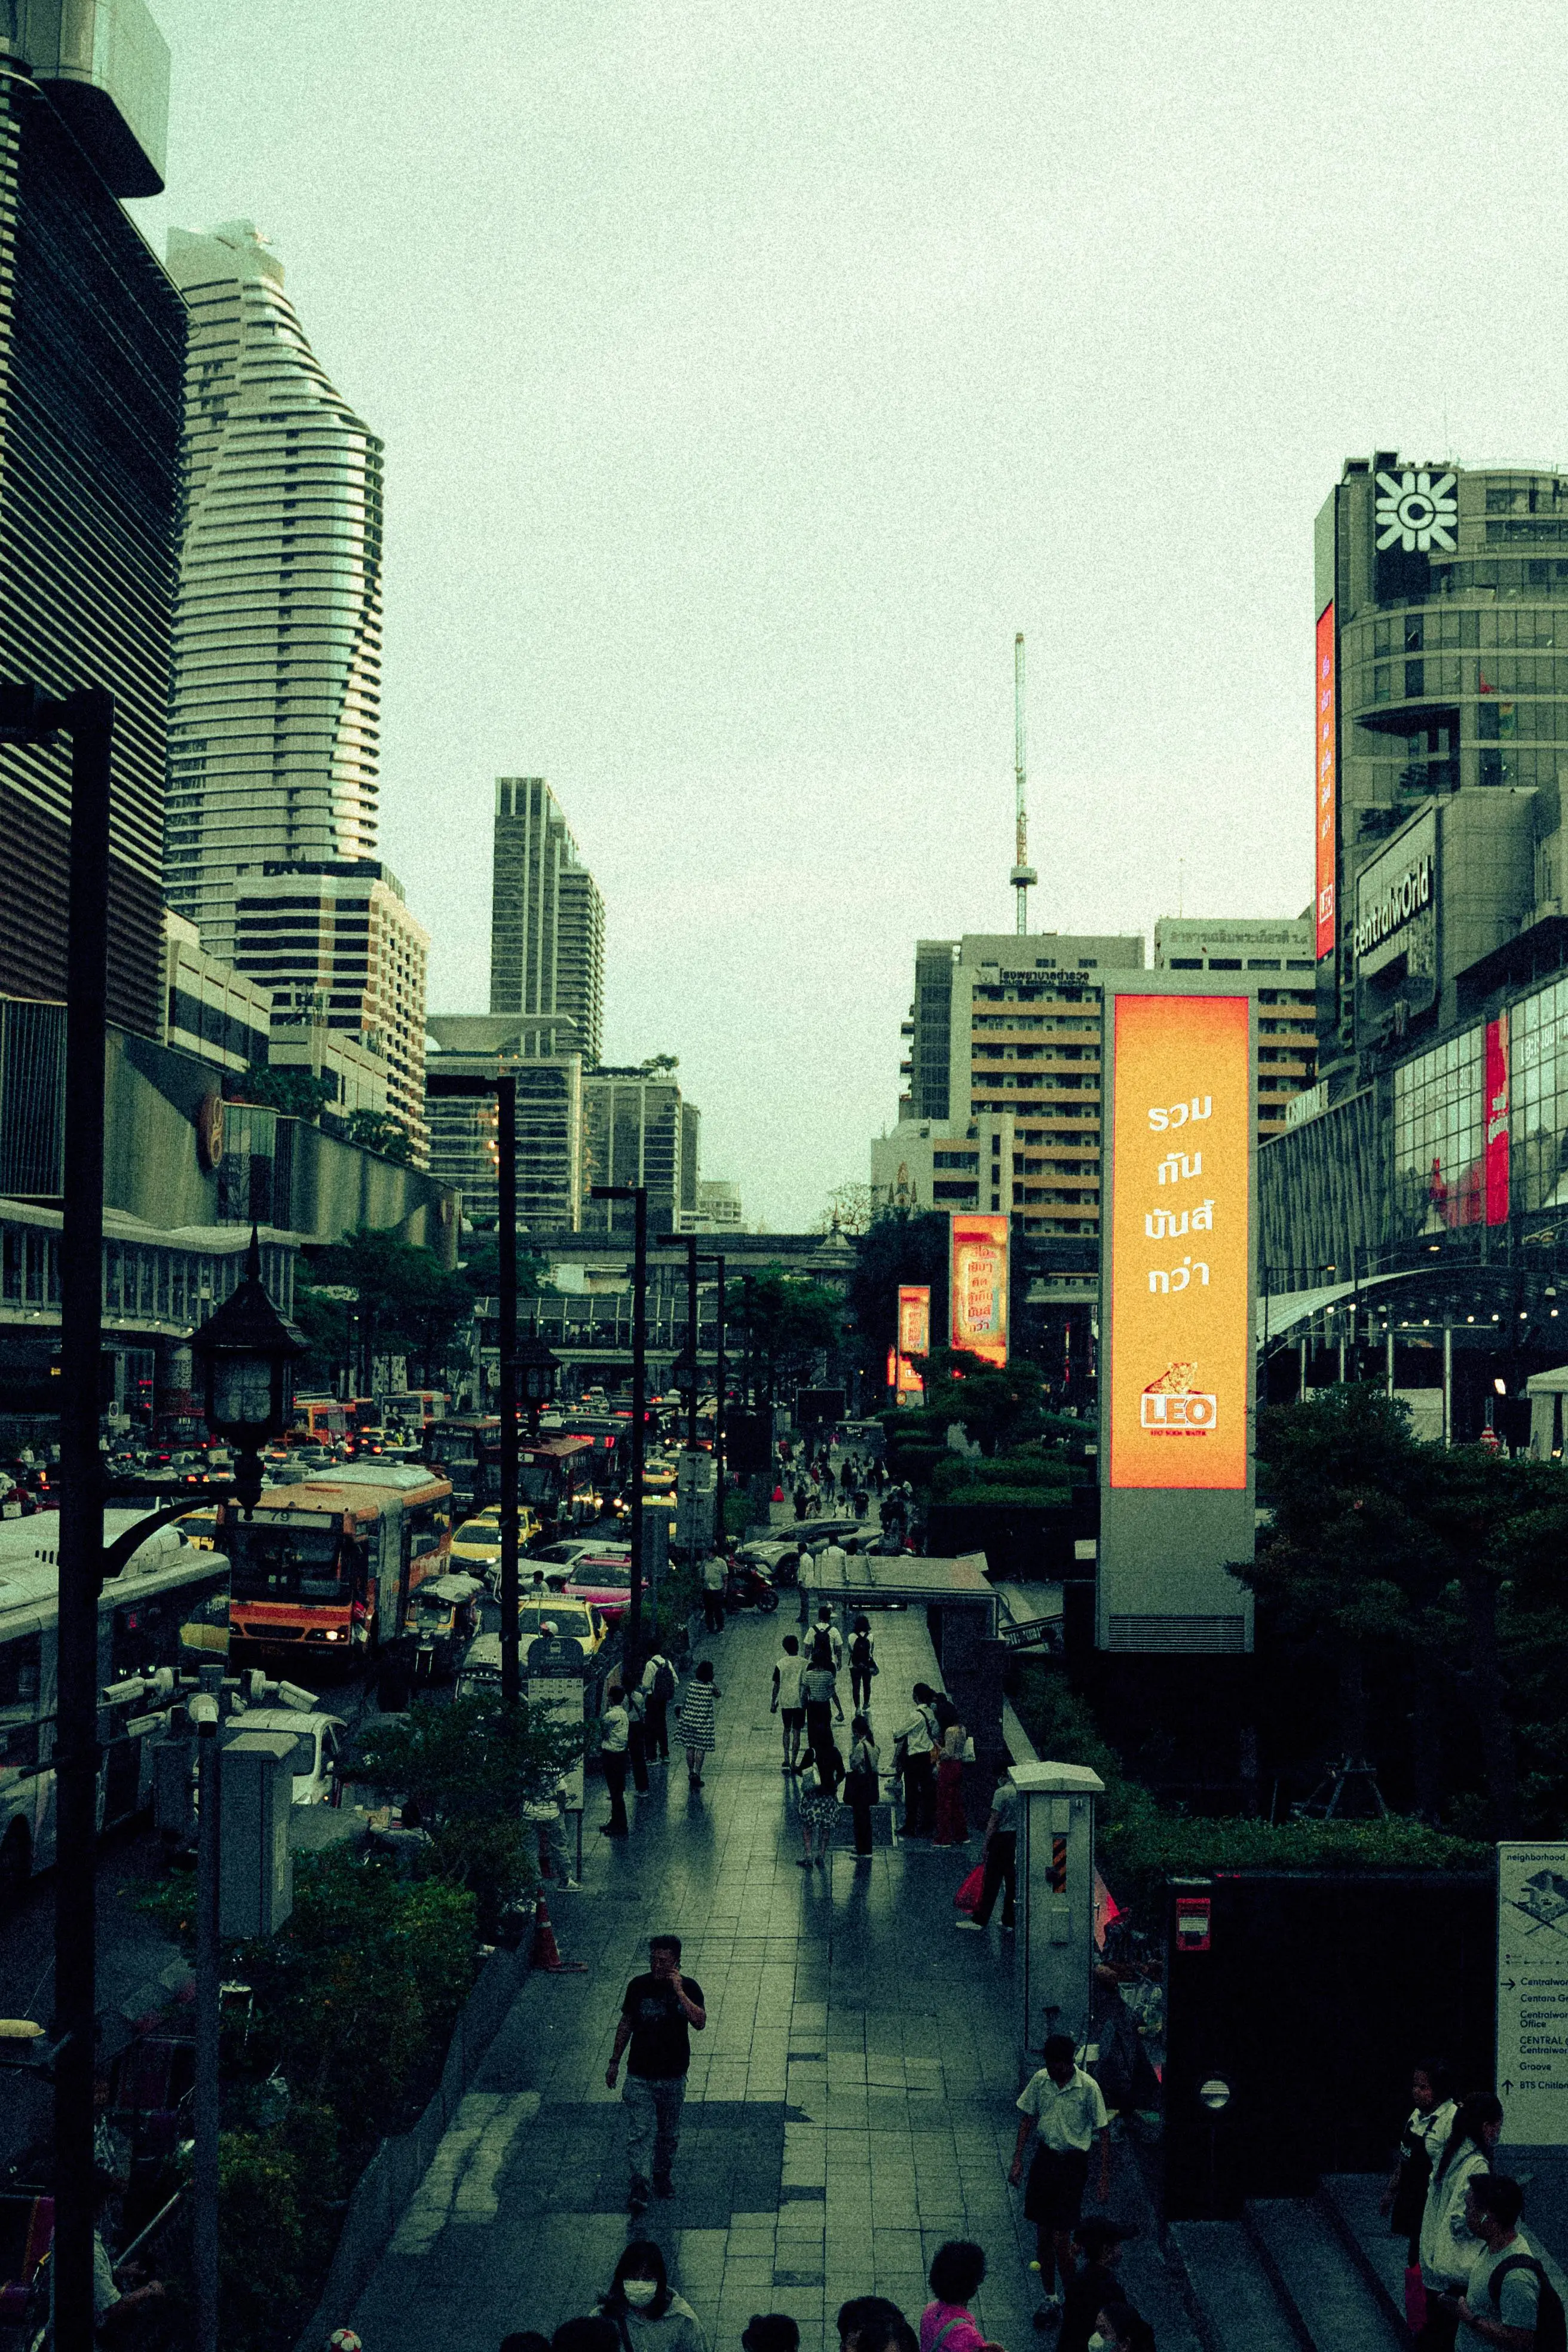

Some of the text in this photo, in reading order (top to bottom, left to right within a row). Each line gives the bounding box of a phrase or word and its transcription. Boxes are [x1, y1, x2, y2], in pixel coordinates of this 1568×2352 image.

[1148, 1095, 1212, 1131] รวม
[1157, 1151, 1202, 1186] กัน
[1148, 1256, 1210, 1294] กว่า
[1145, 1398, 1214, 1425] LEO
[269, 1511, 291, 1522] 79
[1506, 1853, 1566, 1863] neighborhood
[1520, 1993, 1556, 2002] Centara
[1520, 2019, 1546, 2028] Office
[1520, 2036, 1563, 2044] CENTRAL
[1520, 2062, 1552, 2071] Groove
